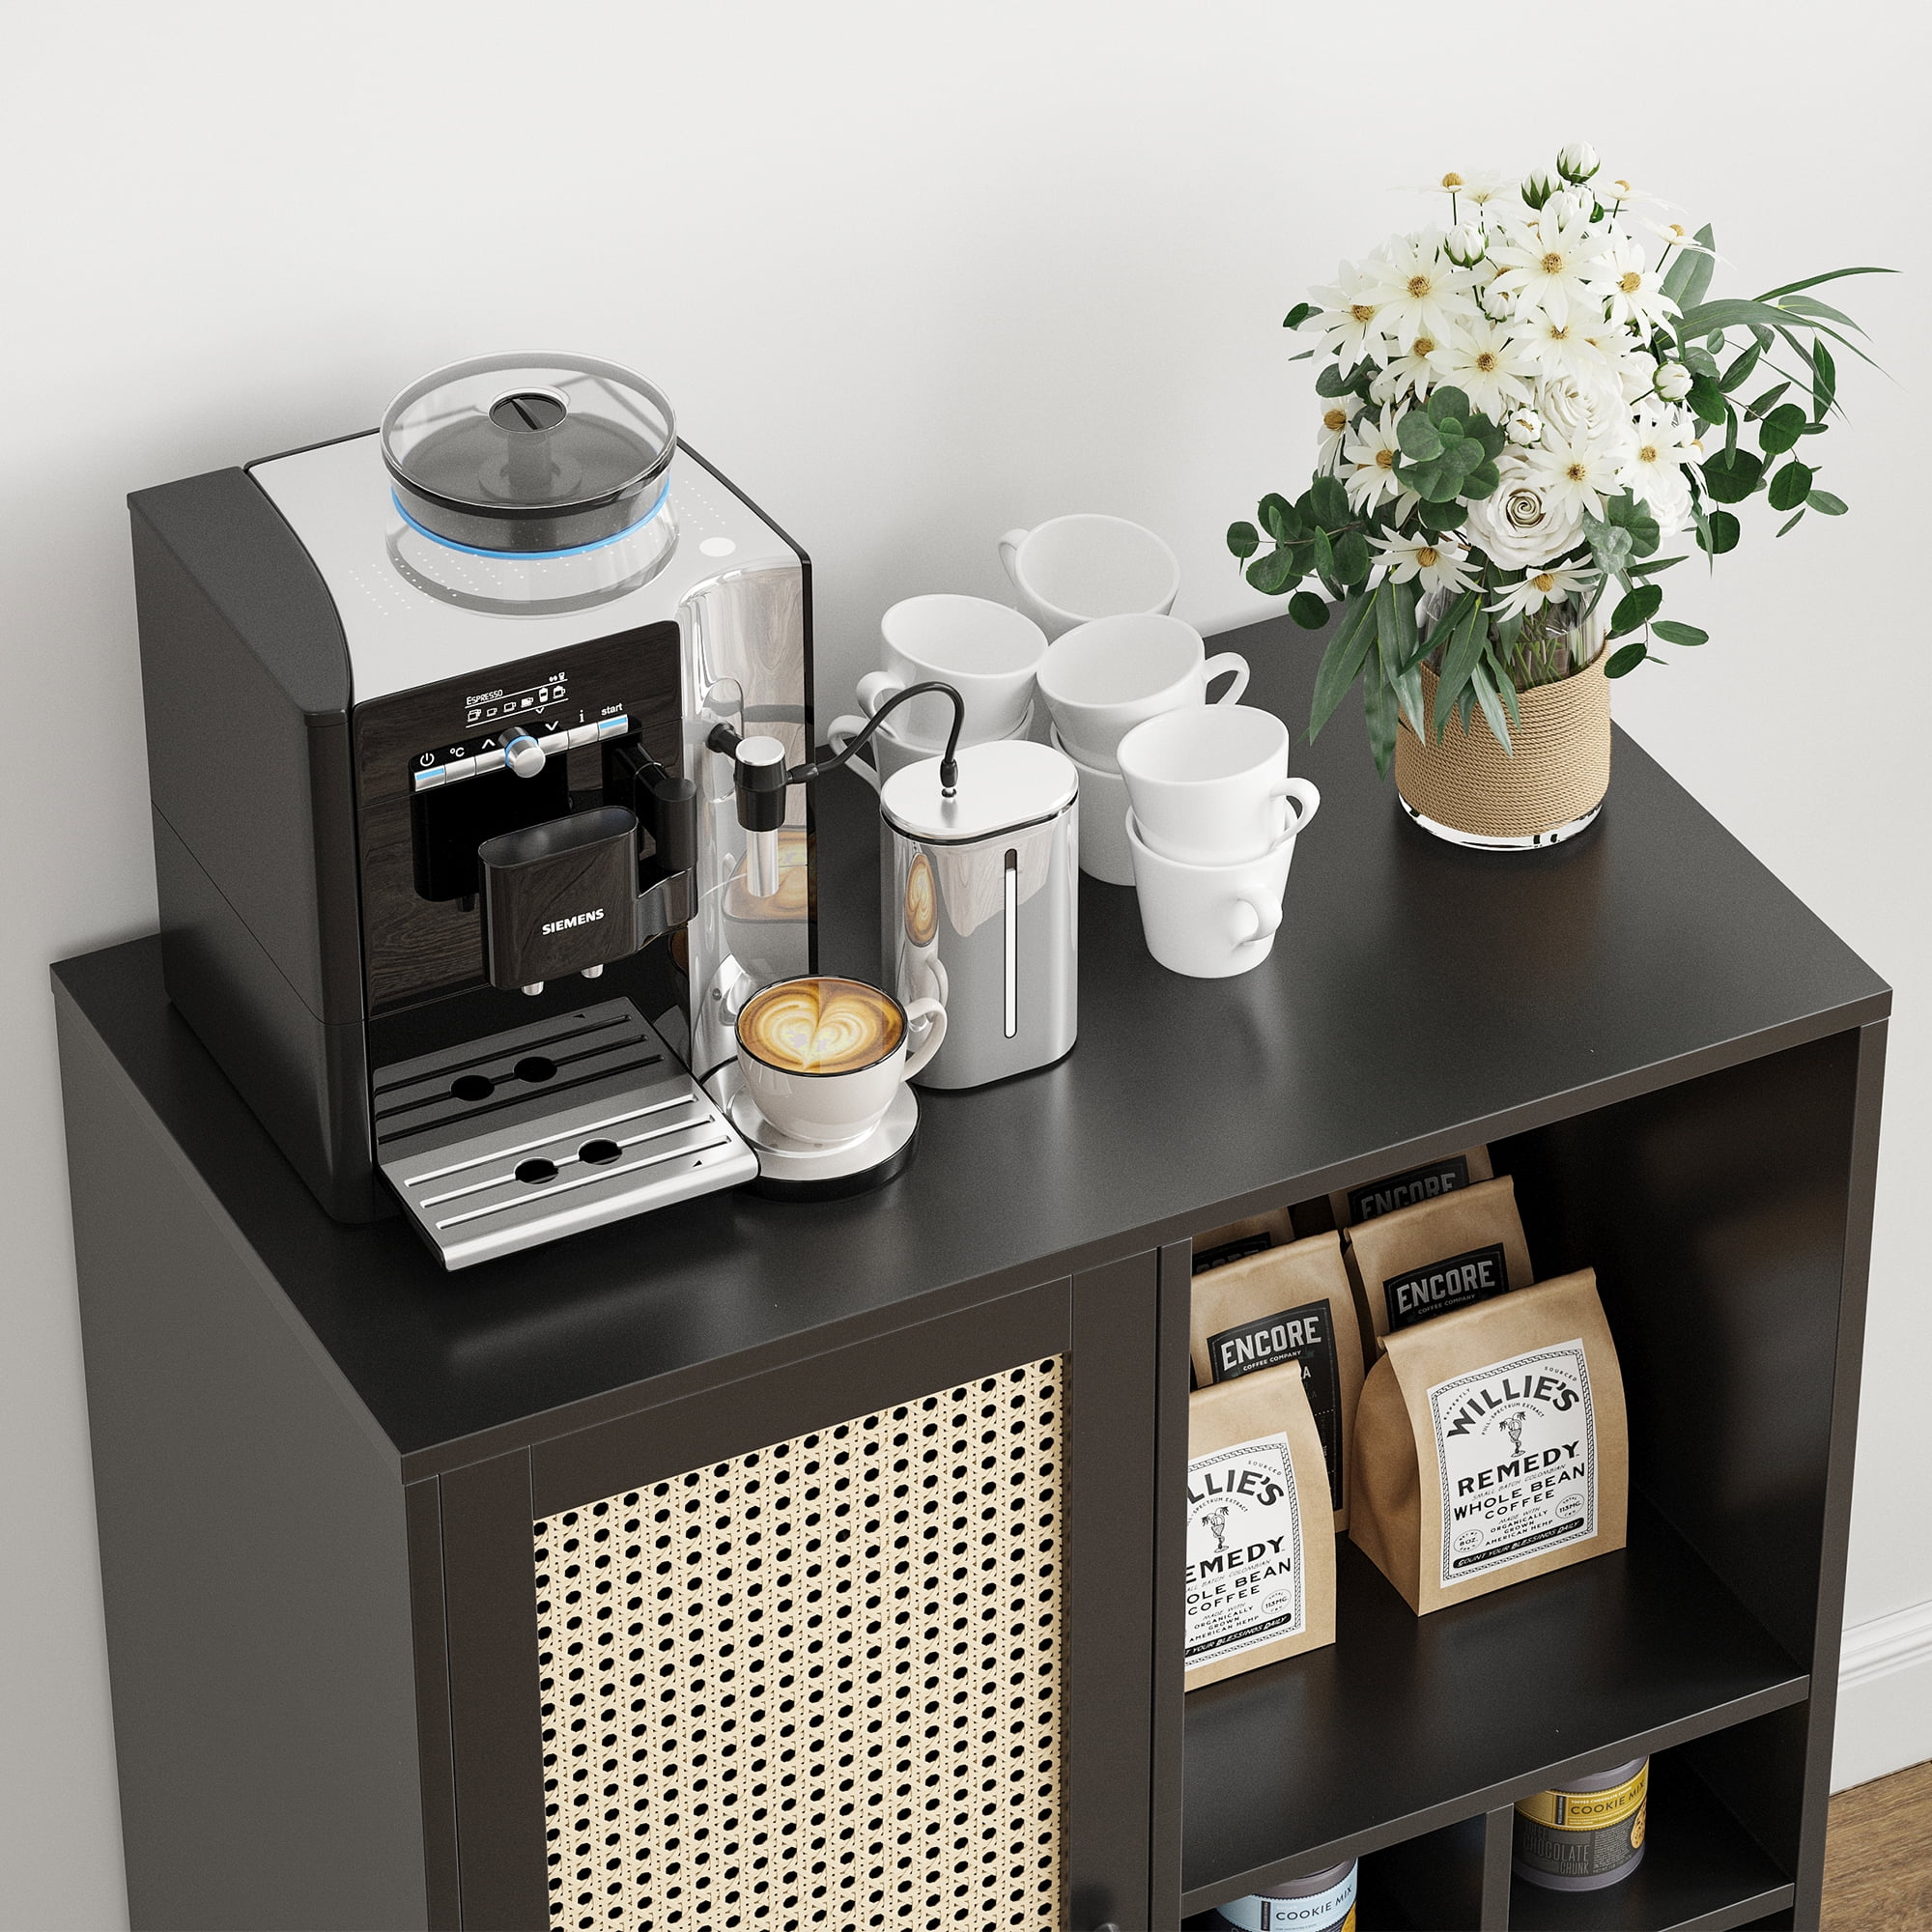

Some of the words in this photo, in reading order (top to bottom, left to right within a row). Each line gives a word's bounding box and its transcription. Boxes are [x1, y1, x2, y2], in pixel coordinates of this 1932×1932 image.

[601, 702, 624, 717] start
[542, 908, 605, 935] SIEMENS
[1396, 1260, 1495, 1315] ENCORE
[1418, 1304, 1443, 1315] COFFEE
[1444, 1293, 1476, 1306] COMPANY
[1220, 1316, 1322, 1372] ENCORE
[1242, 1359, 1267, 1372] COFFEE
[1269, 1350, 1302, 1364] COMPANY
[1544, 1366, 1577, 1382] SOURCED
[1446, 1375, 1580, 1437] WILLIE'S
[1521, 1402, 1545, 1419] EXTRACT
[1247, 1460, 1282, 1476] SOURCED
[1458, 1440, 1579, 1496] REMEDY
[1187, 1469, 1285, 1506] LLIE'S
[1454, 1488, 1522, 1520] WHOLE
[1530, 1463, 1585, 1492] BEAN
[1225, 1497, 1249, 1513] EXTRACT
[1485, 1489, 1555, 1520] COFFEE
[1485, 1528, 1528, 1546] AMERICAN
[1531, 1520, 1554, 1531] HEMP
[1491, 1510, 1548, 1533] ORGANICALLY
[1503, 1520, 1535, 1534] GROWN
[1186, 1535, 1285, 1584] EMEDY
[1458, 1549, 1489, 1567] COUNT
[1187, 1583, 1227, 1605] OLE
[1235, 1557, 1291, 1588] BEAN
[1188, 1584, 1261, 1615] COFFEE
[1189, 1625, 1233, 1642] AMERICAN
[1236, 1615, 1260, 1627] HEMP
[1194, 1605, 1254, 1630] ORGANICALLY
[1208, 1616, 1240, 1631] GROWN
[1571, 1796, 1626, 1815] COOKIE
[1629, 1780, 1645, 1800] MIX
[1523, 1833, 1590, 1862] CHOCOLATE
[1560, 1861, 1590, 1875] CHUNK
[1276, 1901, 1332, 1920] COOKIE
[1335, 1884, 1352, 1906] MIX
